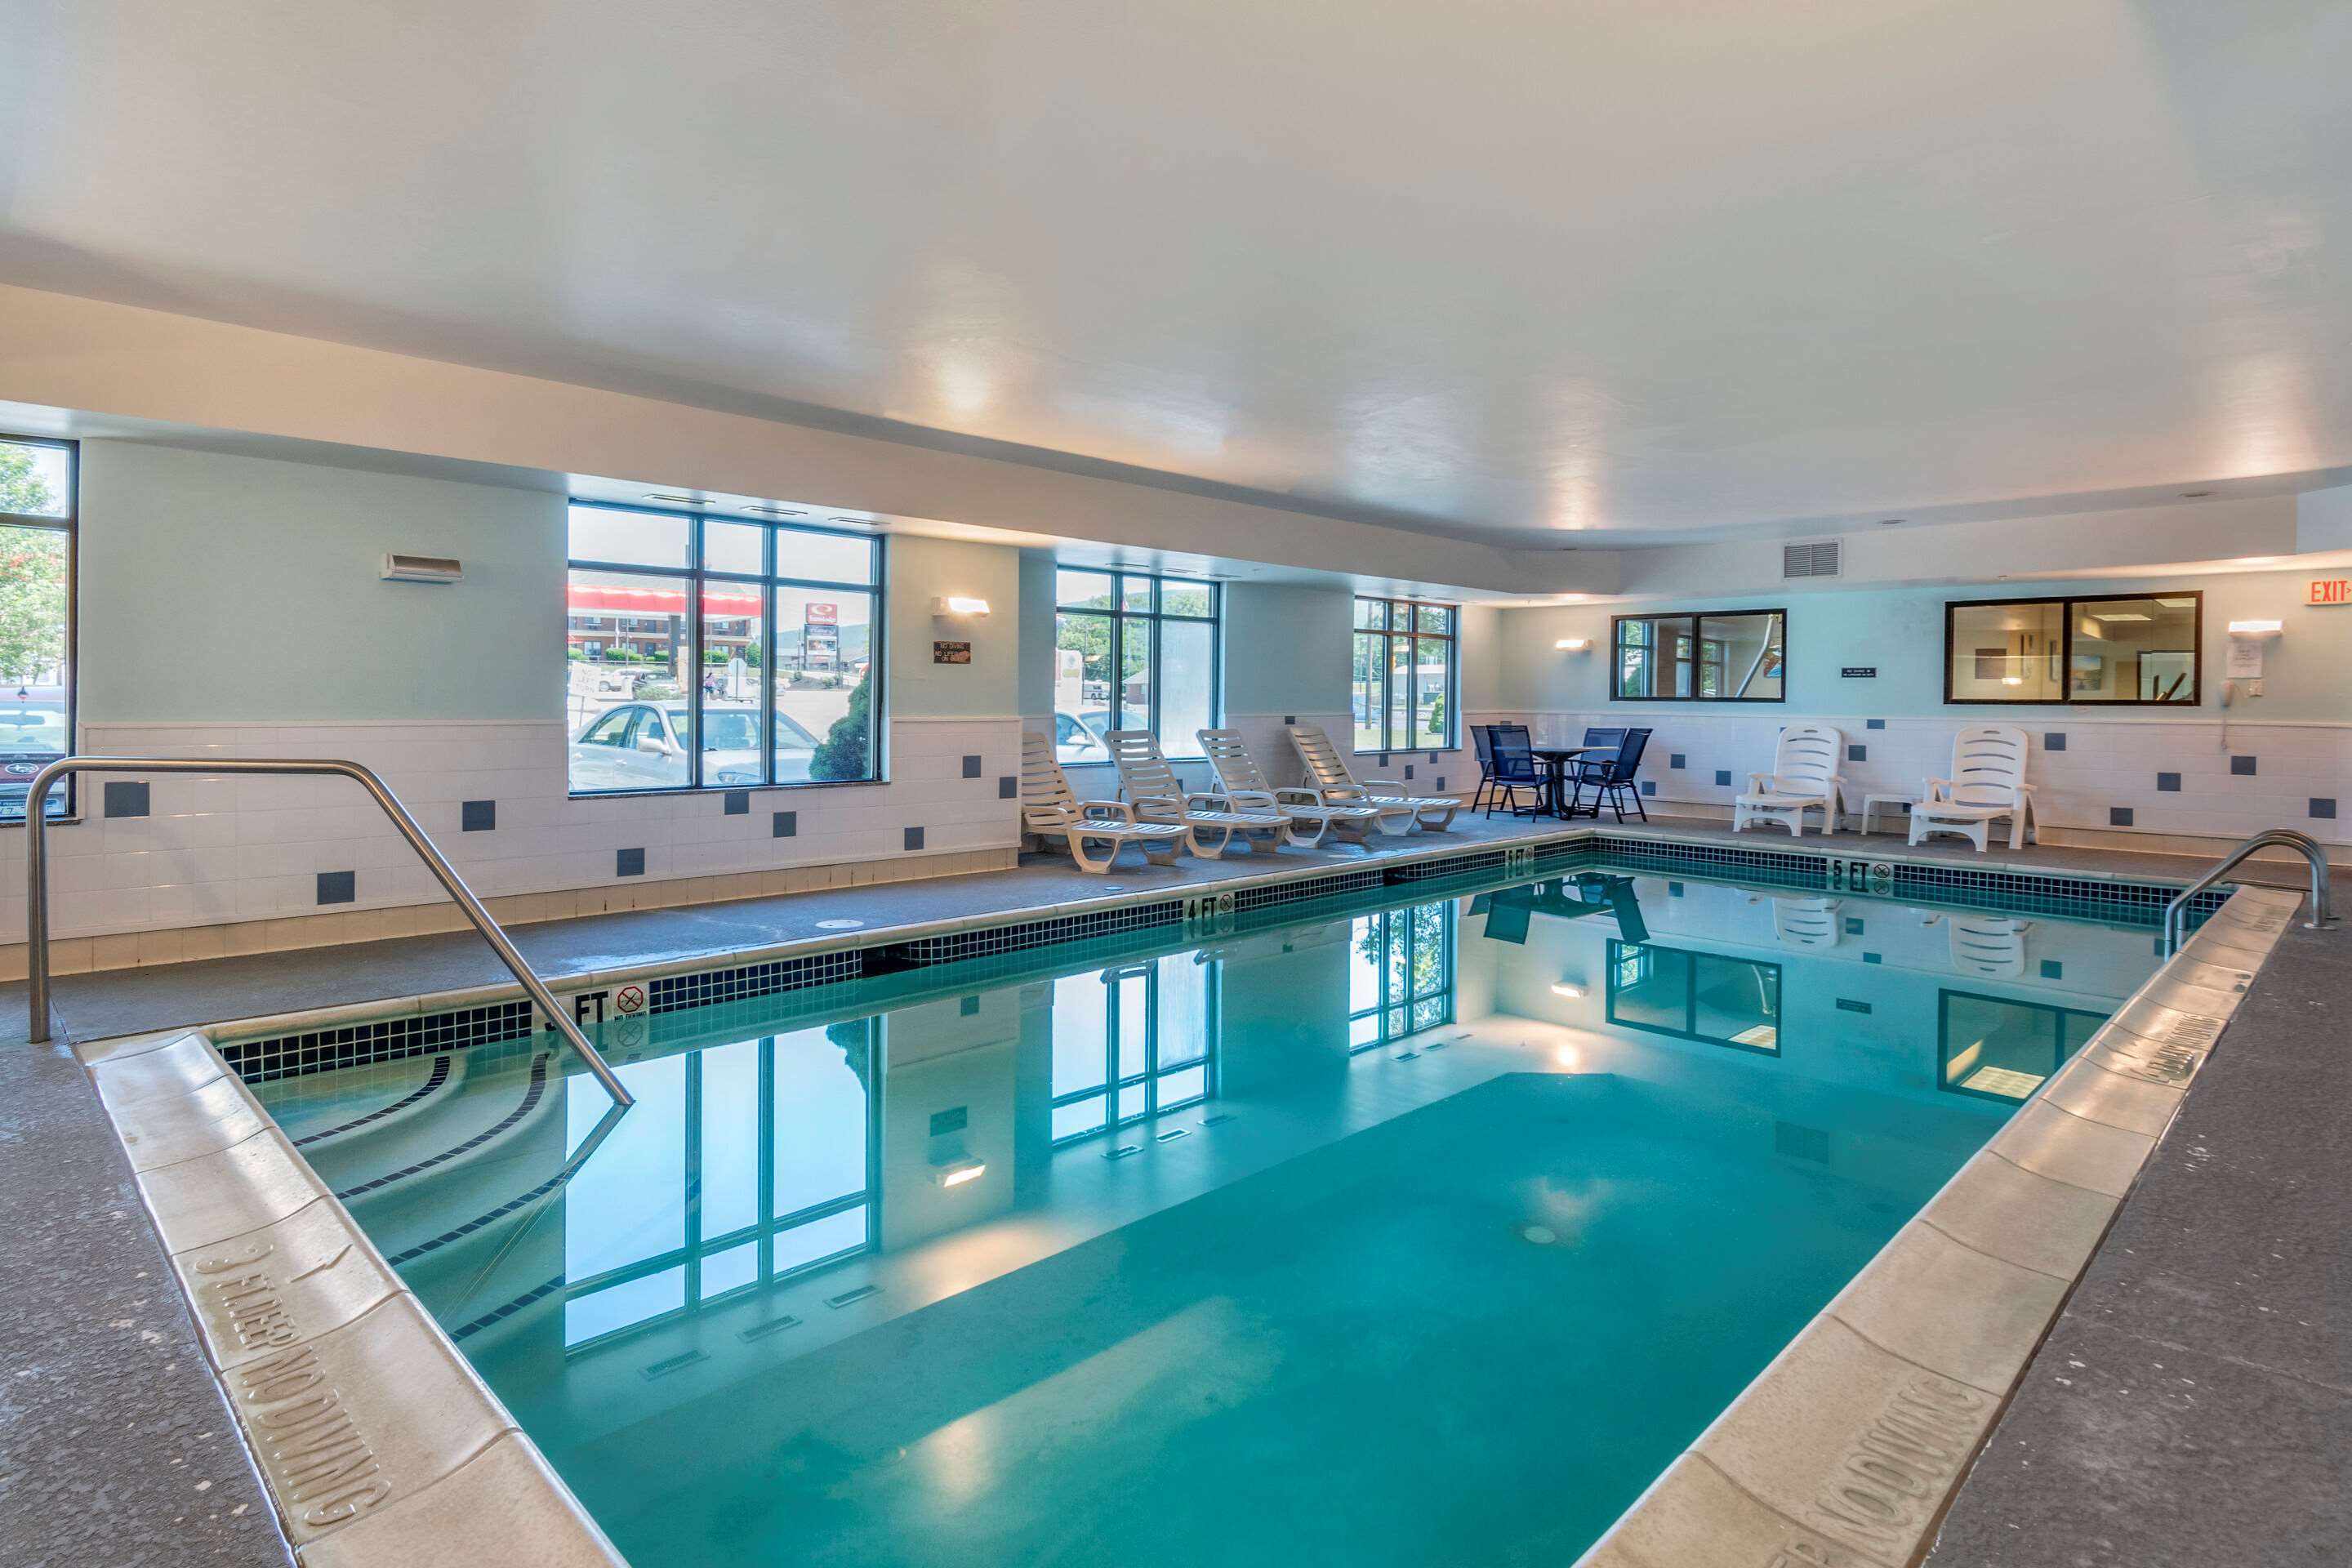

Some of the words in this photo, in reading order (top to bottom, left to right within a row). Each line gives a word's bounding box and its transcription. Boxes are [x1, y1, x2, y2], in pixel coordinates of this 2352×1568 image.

[2311, 581, 2347, 602] EXIT
[1833, 859, 1842, 876] 5
[1850, 862, 1869, 879] FT
[1202, 896, 1217, 919] FT
[575, 991, 609, 1027] FT
[1845, 1375, 1985, 1502] DIVING
[256, 1388, 392, 1527] DIVING
